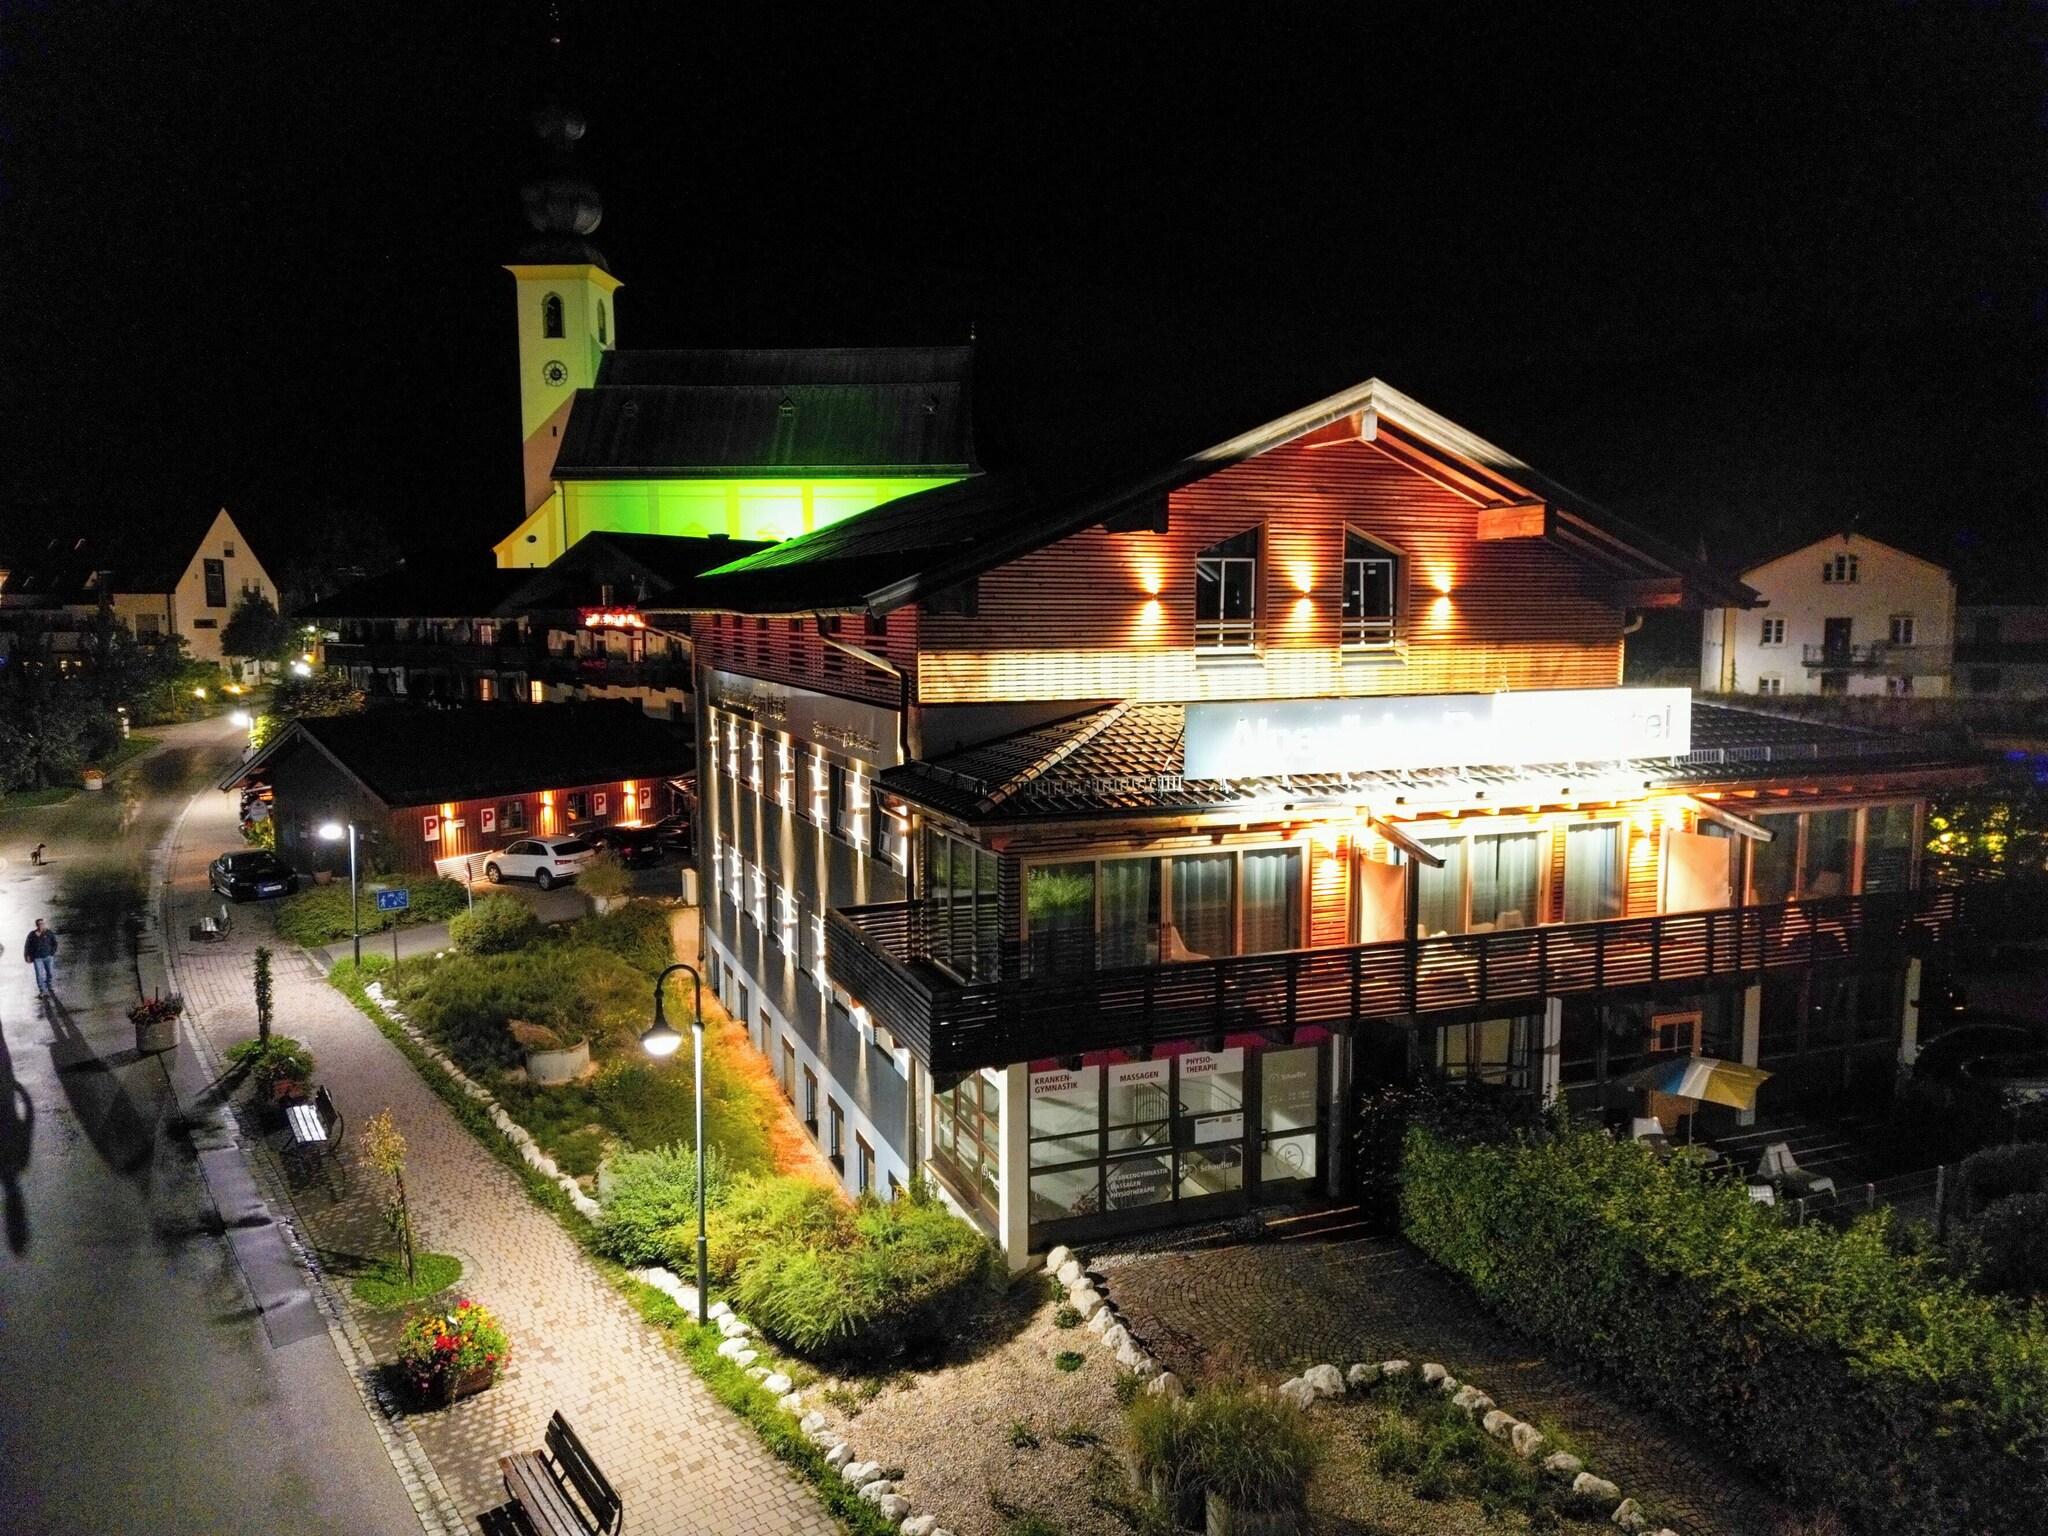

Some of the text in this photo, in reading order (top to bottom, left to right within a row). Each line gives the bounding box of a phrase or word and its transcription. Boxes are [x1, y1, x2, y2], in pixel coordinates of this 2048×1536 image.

[641, 789, 649, 804] P
[595, 795, 605, 811] P
[483, 810, 493, 827] P
[426, 818, 437, 835] P
[1185, 1056, 1213, 1065] PHYSIO-
[1186, 1063, 1218, 1073] THERAPIE
[1034, 1074, 1072, 1085] KRANKEN-
[1119, 1071, 1159, 1082] MASSAGEN
[1034, 1082, 1078, 1094] GYMNASTIK
